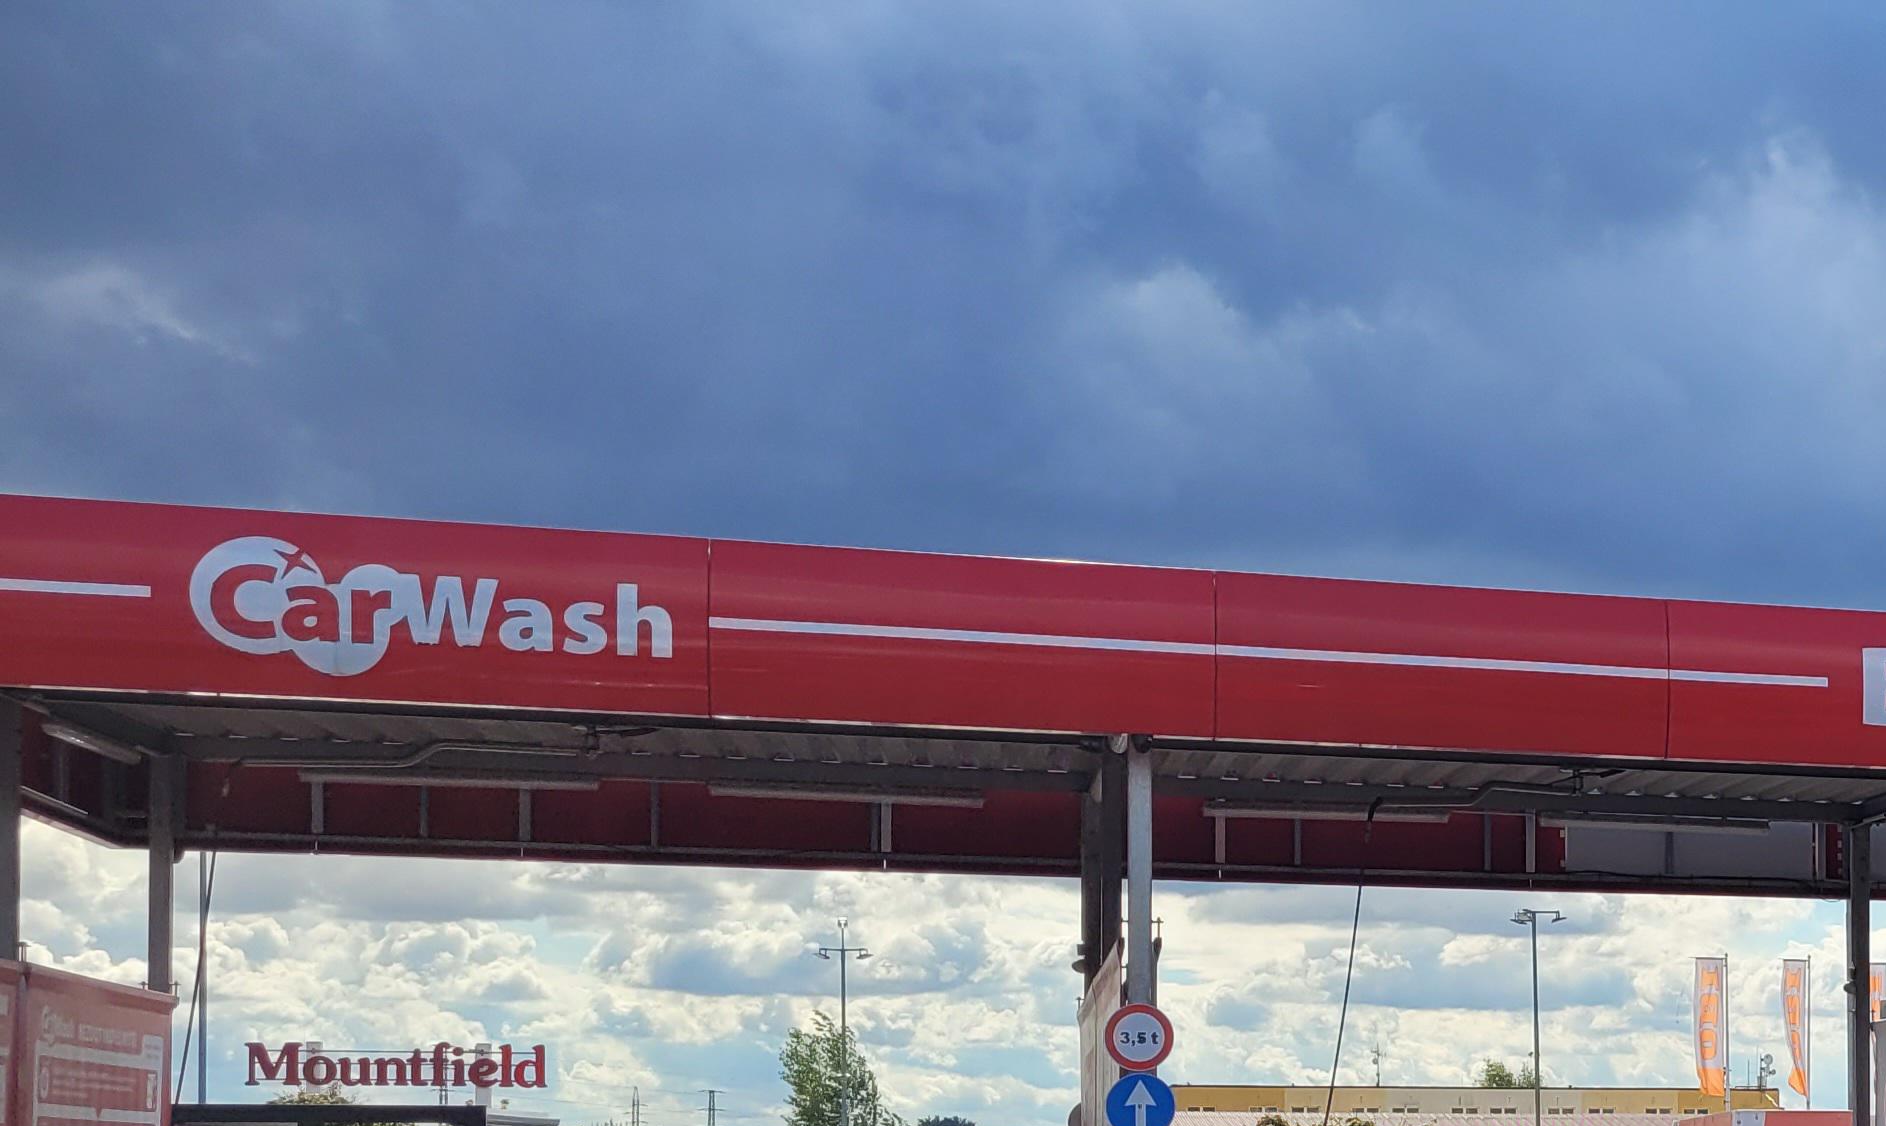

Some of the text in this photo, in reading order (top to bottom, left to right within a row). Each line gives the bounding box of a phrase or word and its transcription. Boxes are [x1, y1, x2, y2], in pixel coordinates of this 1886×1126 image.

[196, 542, 674, 670] CarWash
[1120, 1032, 1159, 1046] 3,5 t
[245, 1042, 548, 1088] Mountfield
